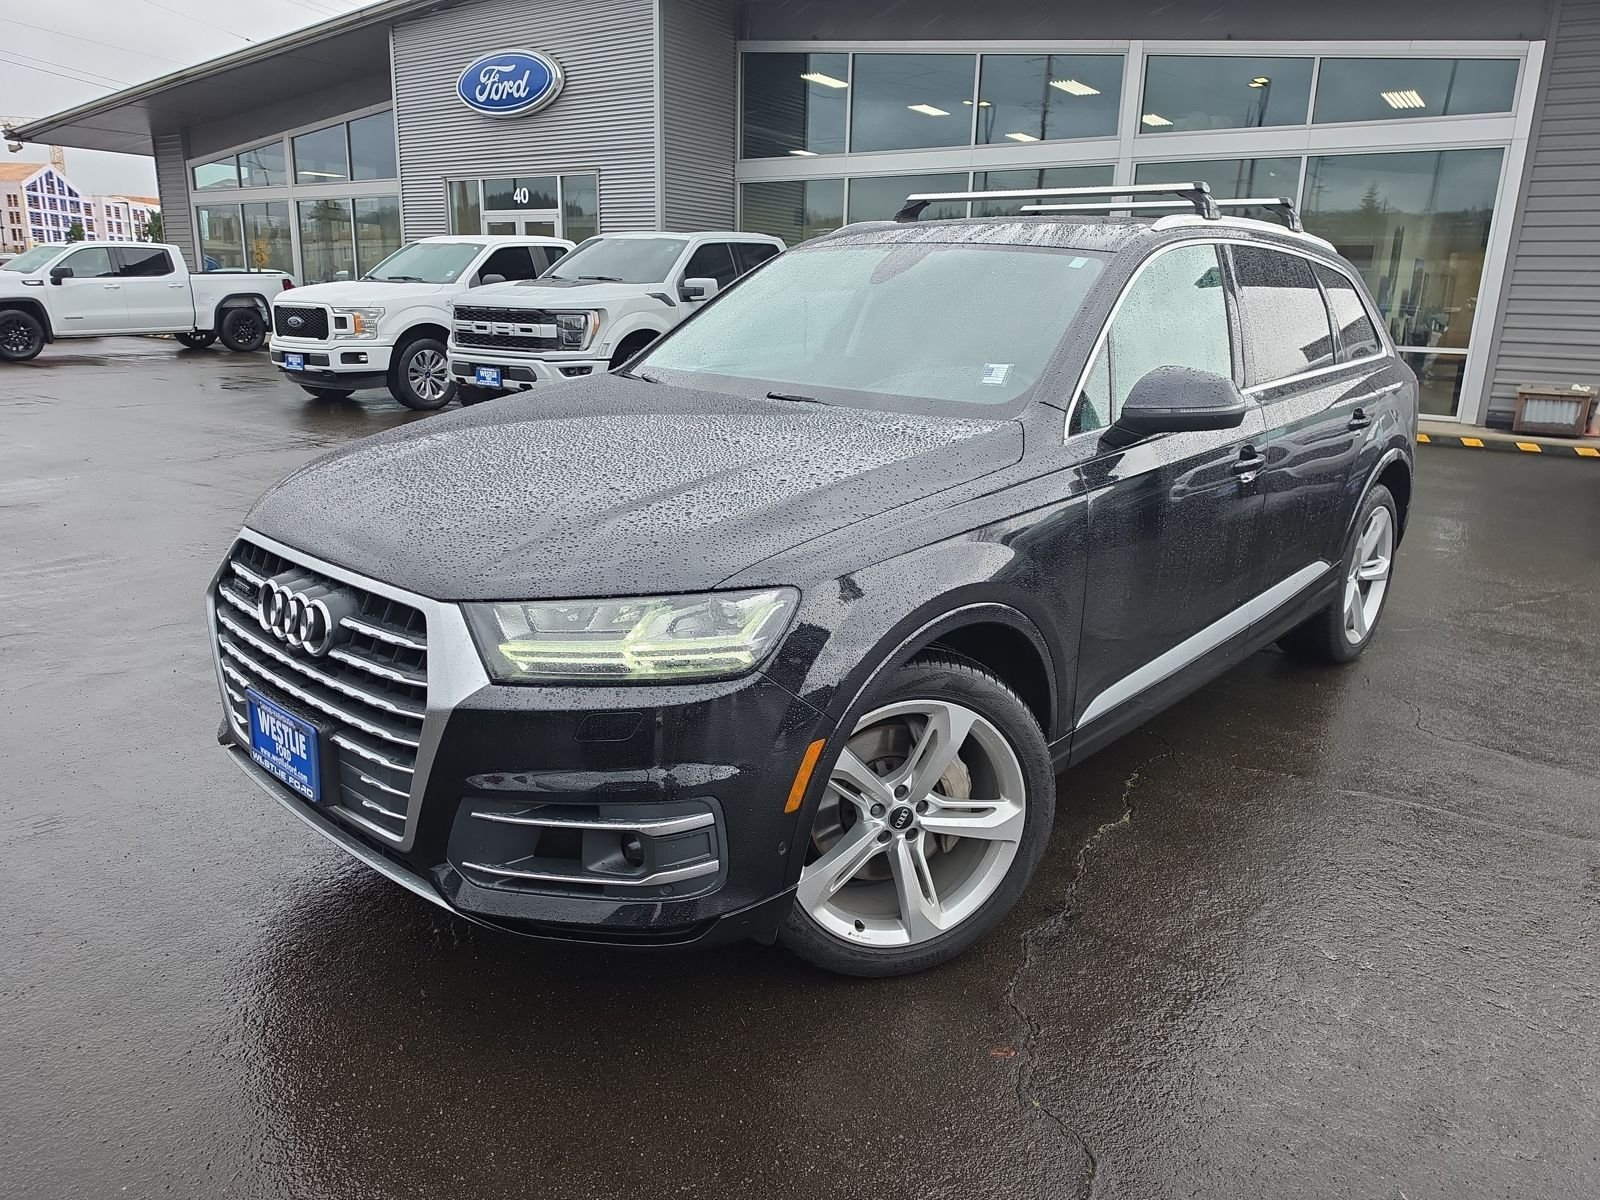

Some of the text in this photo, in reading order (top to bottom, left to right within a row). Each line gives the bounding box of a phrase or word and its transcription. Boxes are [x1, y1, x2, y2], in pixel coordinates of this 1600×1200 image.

[475, 64, 531, 102] Ford
[513, 187, 529, 204] 40
[454, 320, 542, 337] FORD
[257, 707, 307, 761] WESTLIE
[275, 742, 292, 762] FORD
